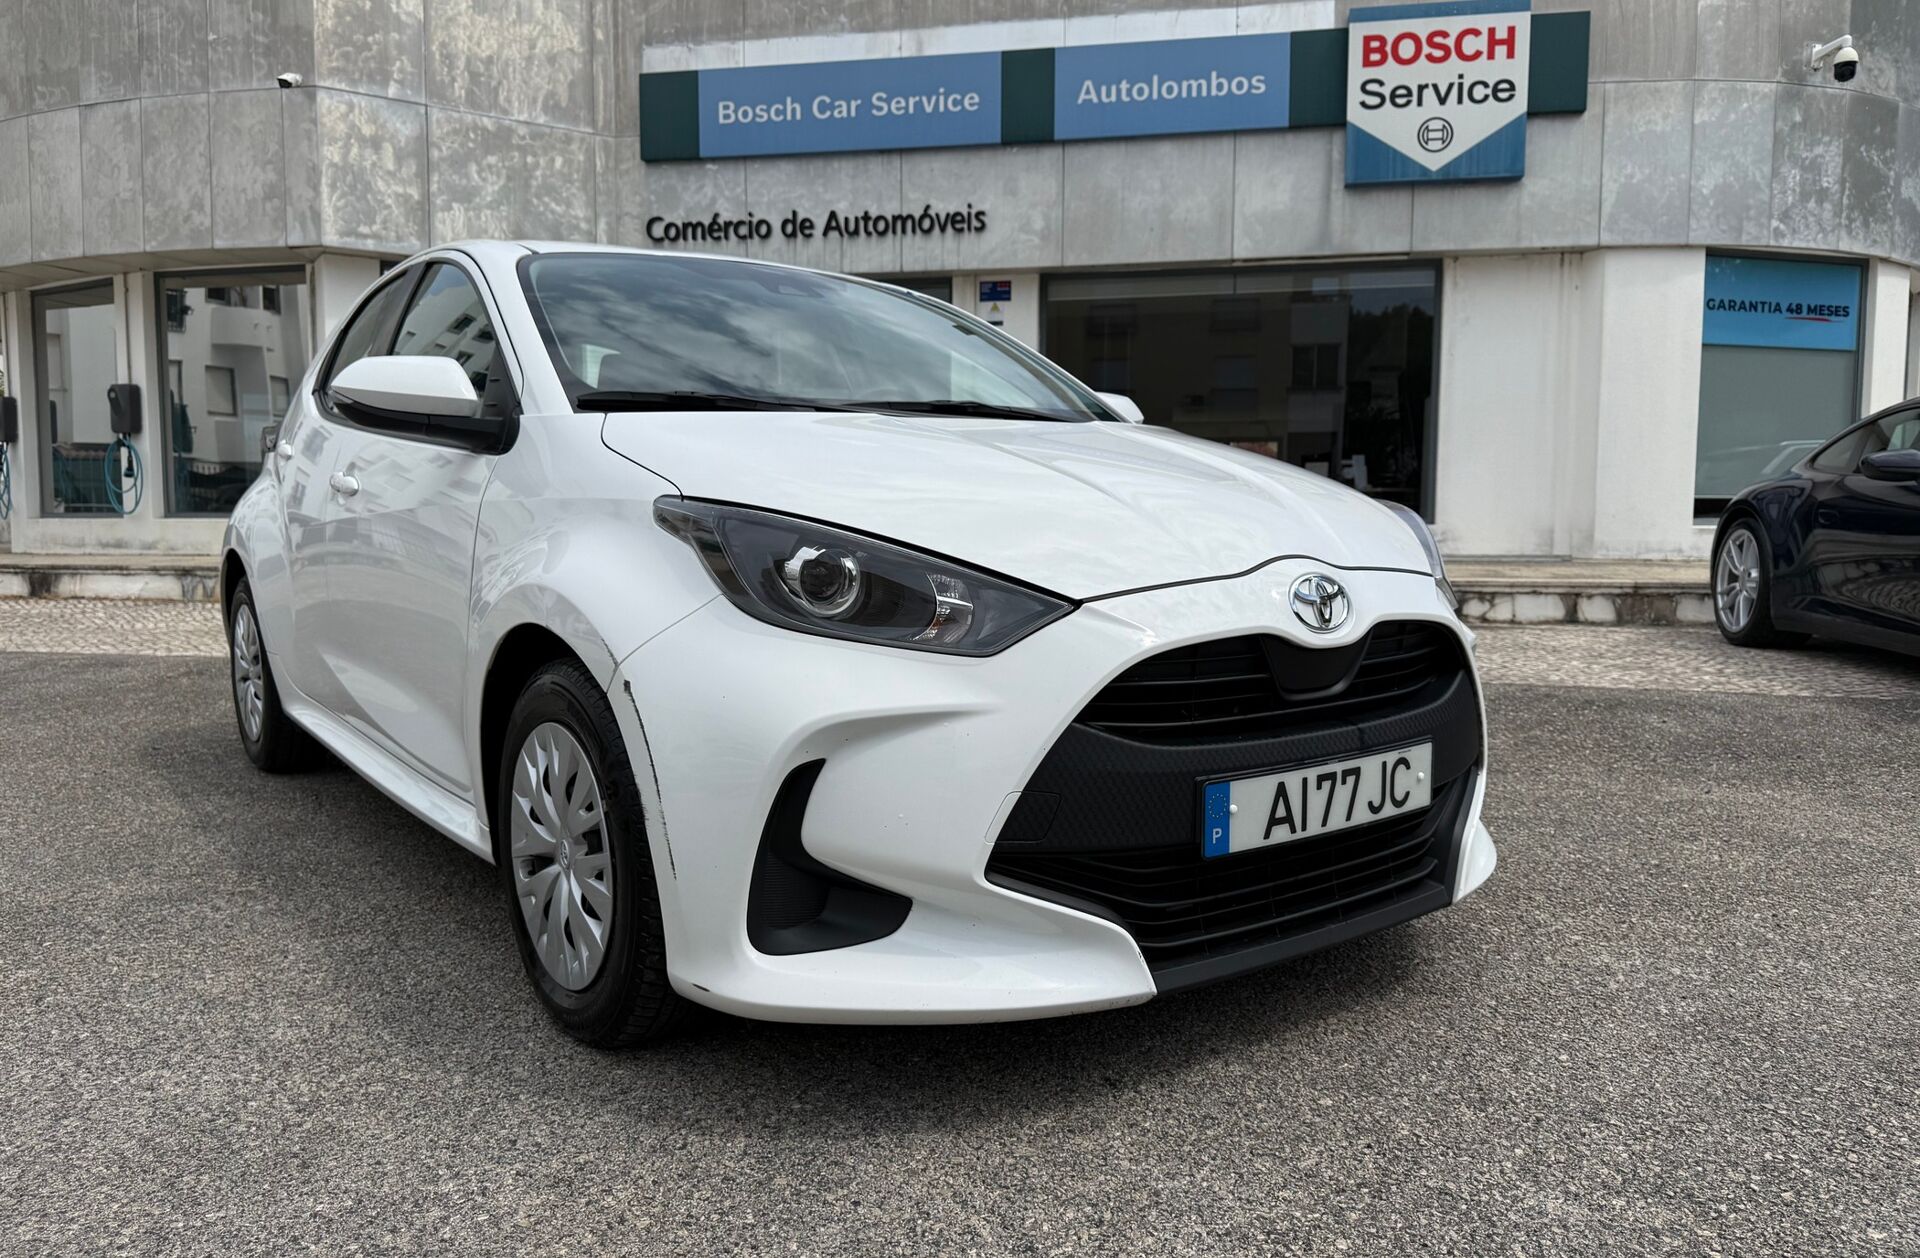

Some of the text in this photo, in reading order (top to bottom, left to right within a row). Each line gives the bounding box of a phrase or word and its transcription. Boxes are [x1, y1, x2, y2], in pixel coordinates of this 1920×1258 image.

[1362, 25, 1516, 68] BOSCH
[718, 87, 980, 124] Bosch Car Service
[1077, 70, 1267, 104] Autolombos
[1359, 73, 1517, 110] Service
[646, 203, 987, 242] Comércio de Automóveis
[1706, 298, 1850, 317] GARANTIA 48 MESES
[1212, 827, 1222, 844] P
